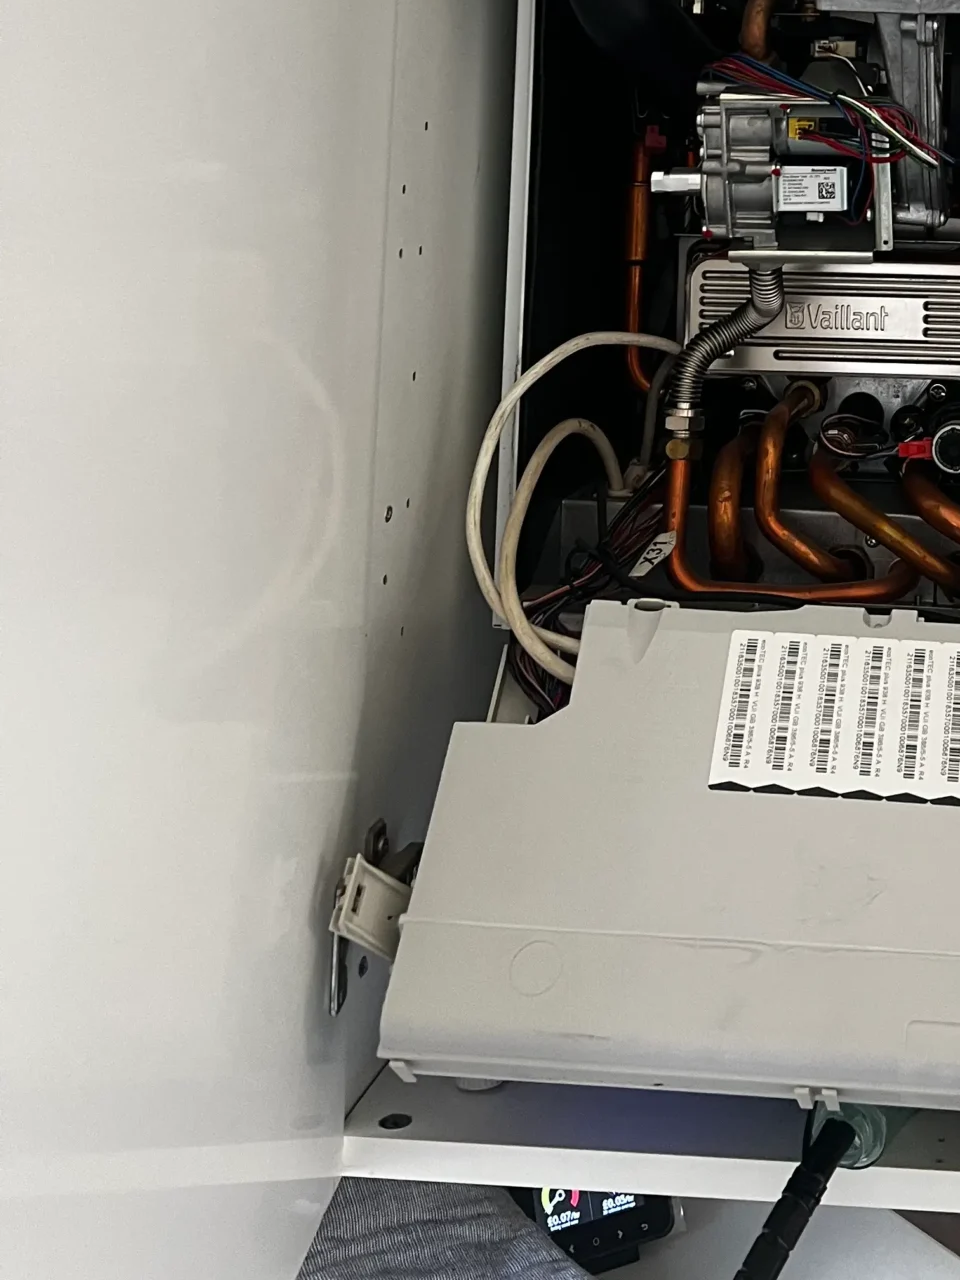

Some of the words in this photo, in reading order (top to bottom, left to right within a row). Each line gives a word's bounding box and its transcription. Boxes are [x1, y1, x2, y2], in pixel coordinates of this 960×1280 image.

[807, 303, 889, 331] Vaillant
[639, 541, 668, 566] X31
[758, 639, 767, 663] ecoTEC
[800, 641, 809, 665] ecoTEC
[842, 644, 850, 668] ecoTEC
[884, 646, 893, 670] ecoTEC
[927, 649, 935, 673] ecoTEC
[755, 664, 763, 677] plus
[797, 666, 805, 679] plus
[839, 669, 847, 682] plus
[882, 671, 890, 685] plus
[924, 674, 932, 688] plus
[749, 713, 756, 723] GB
[792, 715, 799, 726] GB
[835, 718, 841, 729] GB
[878, 721, 885, 732] GB
[921, 724, 928, 735] GB
[742, 759, 749, 769] R4
[786, 761, 793, 771] R4
[829, 764, 836, 774] R4
[873, 767, 880, 777] R4
[917, 770, 924, 780] R4
